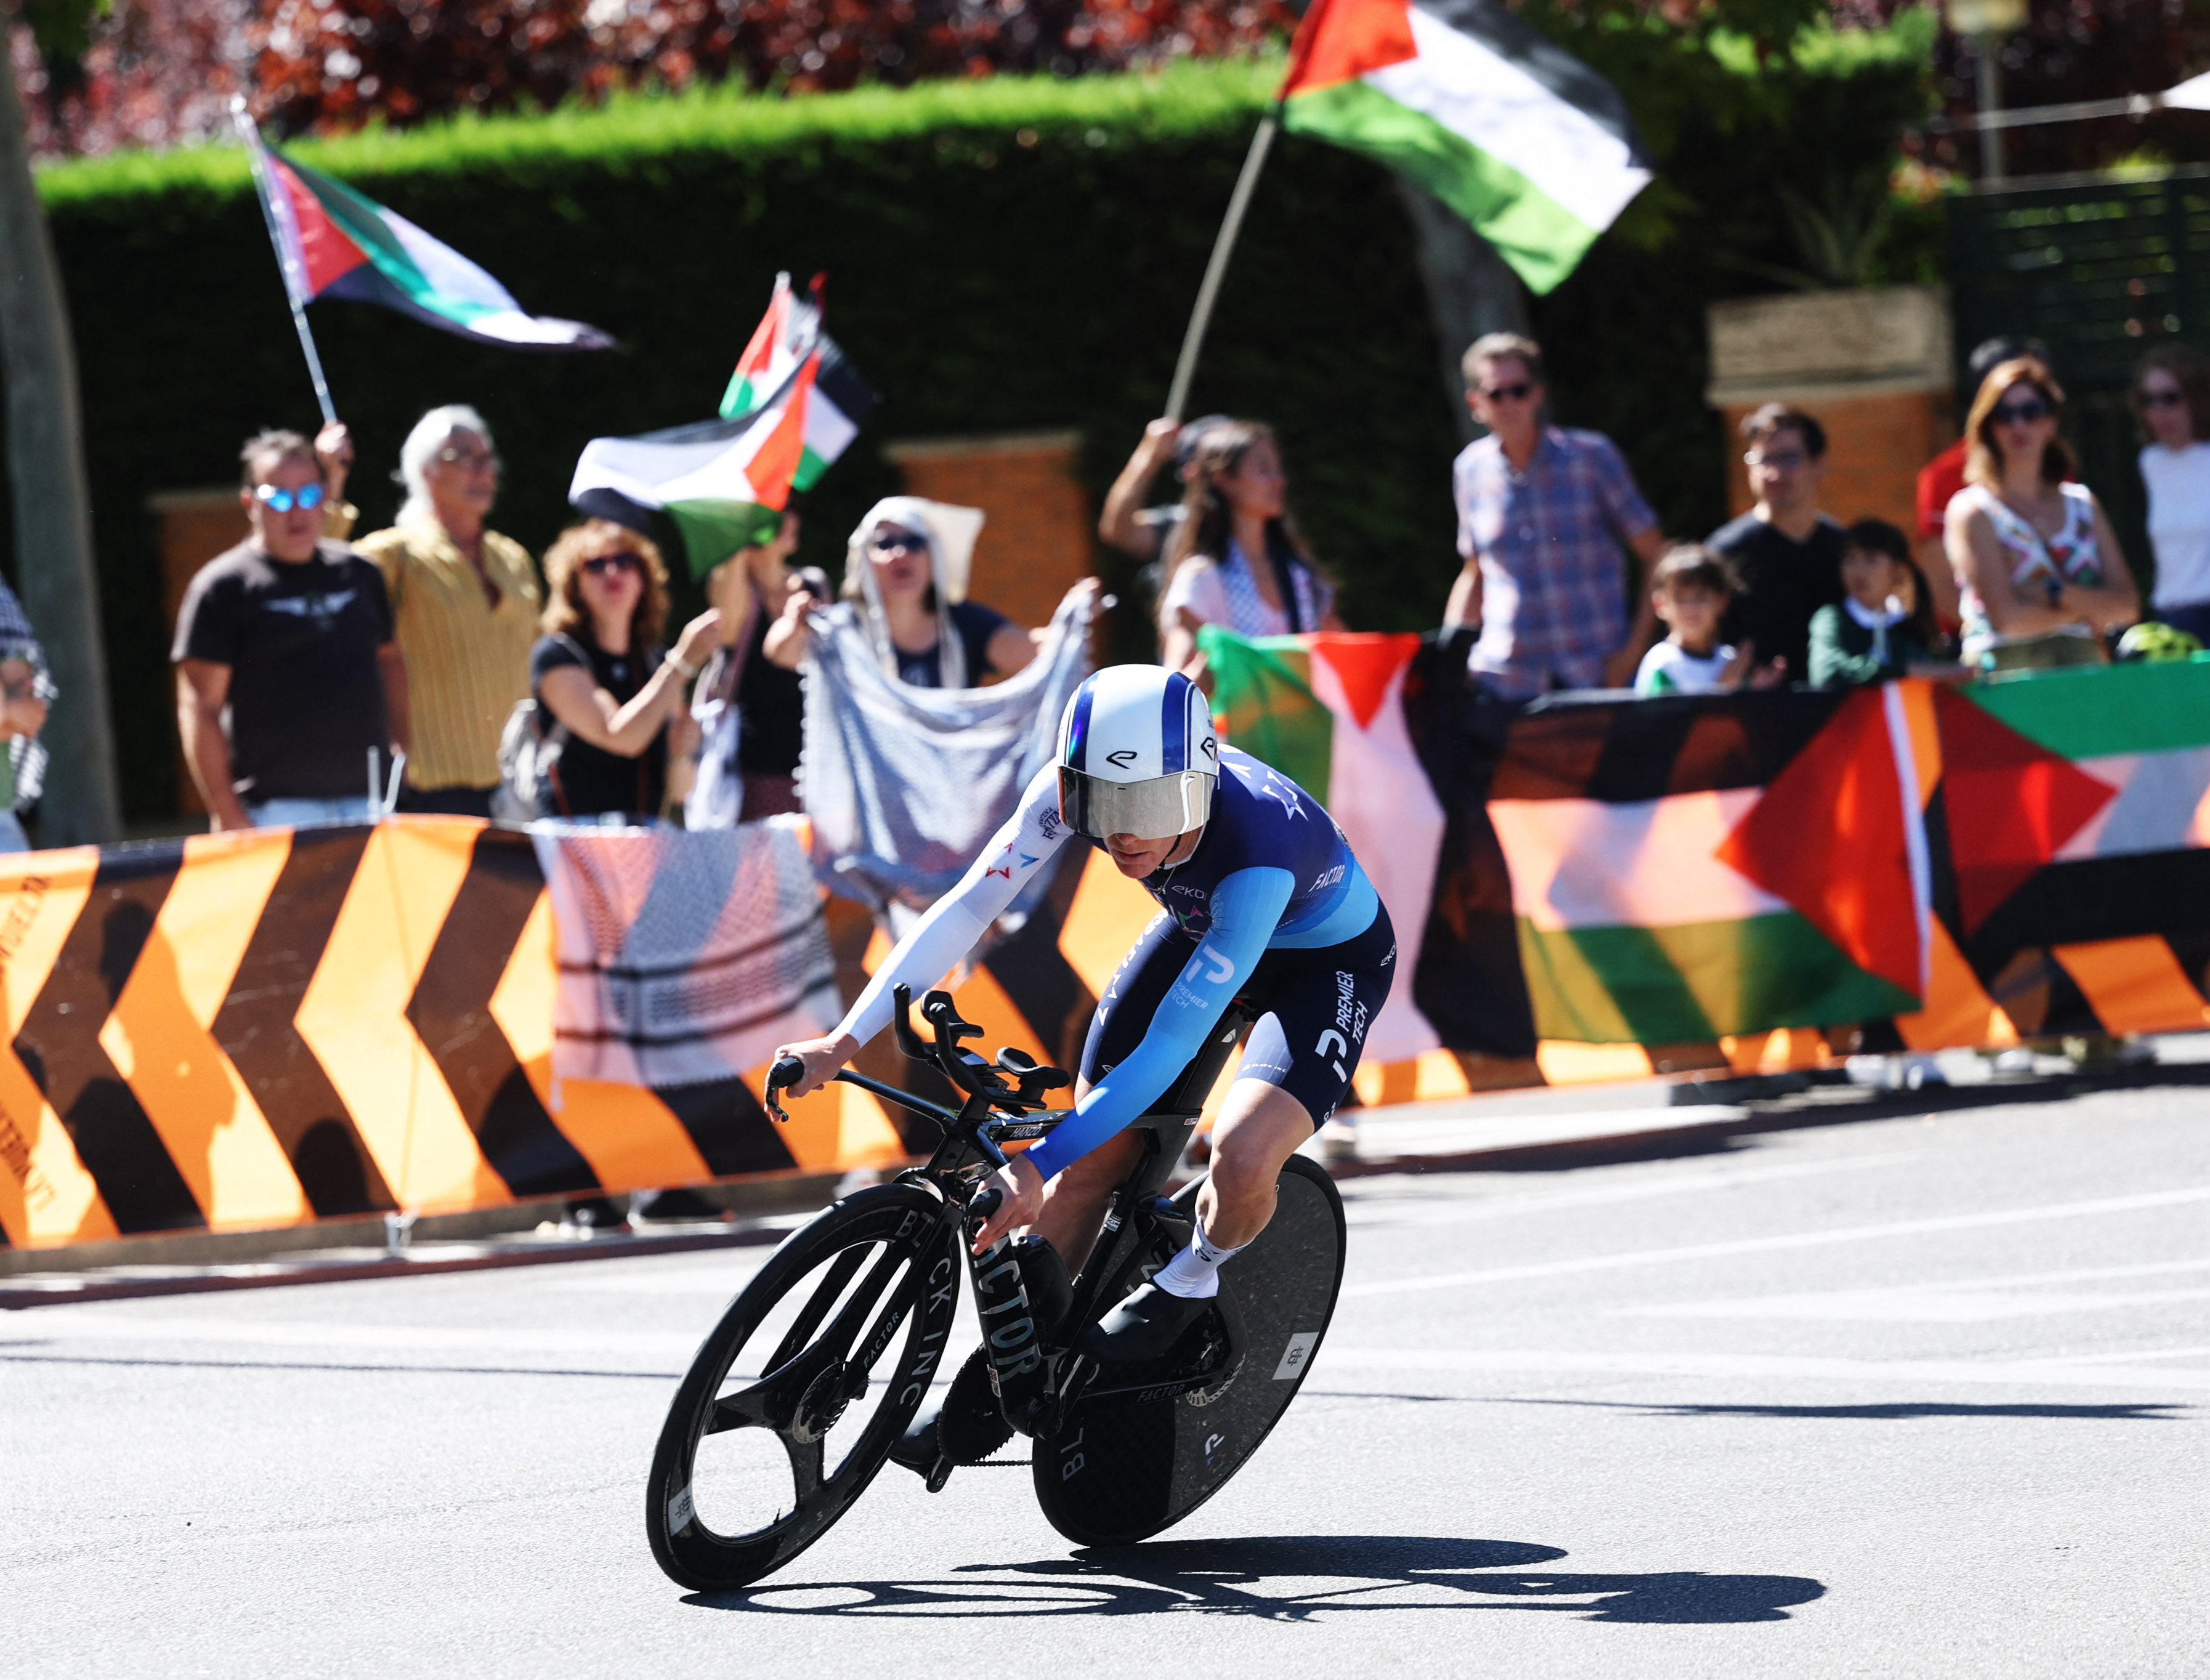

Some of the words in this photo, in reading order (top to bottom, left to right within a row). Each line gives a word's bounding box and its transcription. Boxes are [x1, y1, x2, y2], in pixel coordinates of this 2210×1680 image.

[1308, 864, 1345, 892] FACTOR
[1170, 988, 1190, 1009] TECH
[1176, 981, 1208, 1010] PREMIER
[1335, 971, 1354, 1032] PREMIER
[1352, 1000, 1369, 1045] TECH
[973, 1229, 1042, 1383] ACTOR
[864, 1311, 901, 1369] FACTOR
[899, 1330, 944, 1408] INC
[1137, 1384, 1185, 1403] FACTOR
